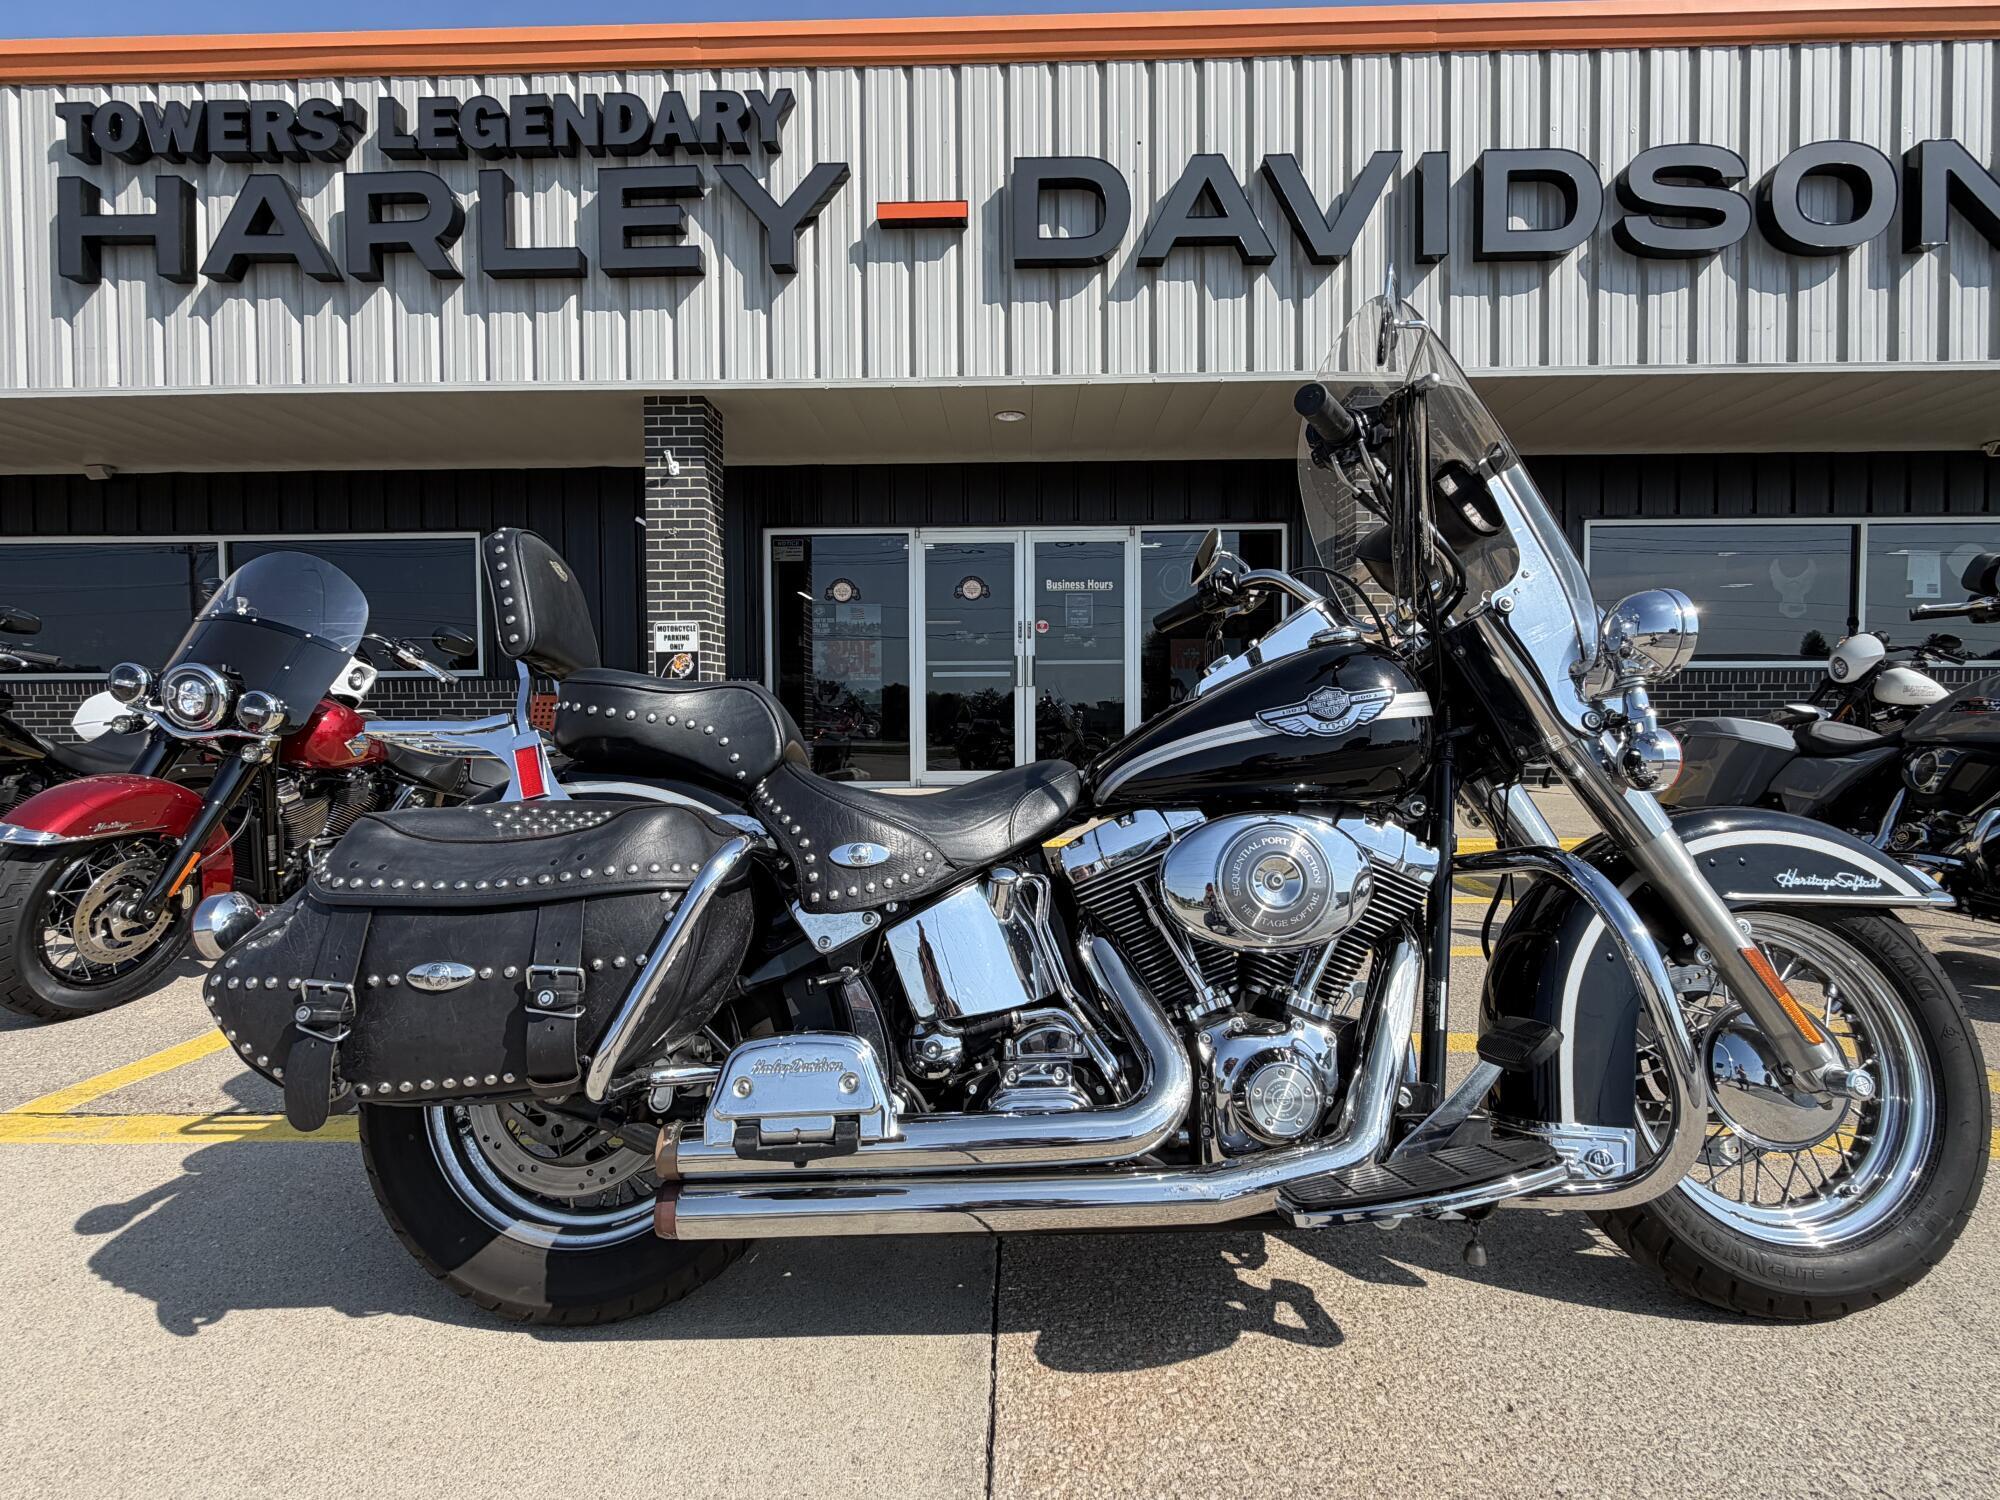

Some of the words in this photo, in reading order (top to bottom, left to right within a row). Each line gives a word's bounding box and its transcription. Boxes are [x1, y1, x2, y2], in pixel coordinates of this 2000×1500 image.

[378, 88, 795, 160] LEGENDARY
[58, 162, 850, 284] HARLEY
[1014, 138, 2000, 268] DAVIDSON
[1046, 579, 1085, 590] Business
[1088, 578, 1114, 590] Hours
[656, 625, 697, 633] MOTORCYCLE
[663, 634, 691, 642] PARKING
[669, 643, 686, 651] ONLY
[1231, 842, 1261, 896] SEQUENTIAL
[1261, 836, 1290, 847] PORT
[1290, 839, 1321, 884] INJECTION
[1776, 868, 1836, 890] Heritage
[1834, 872, 1882, 891] Softail
